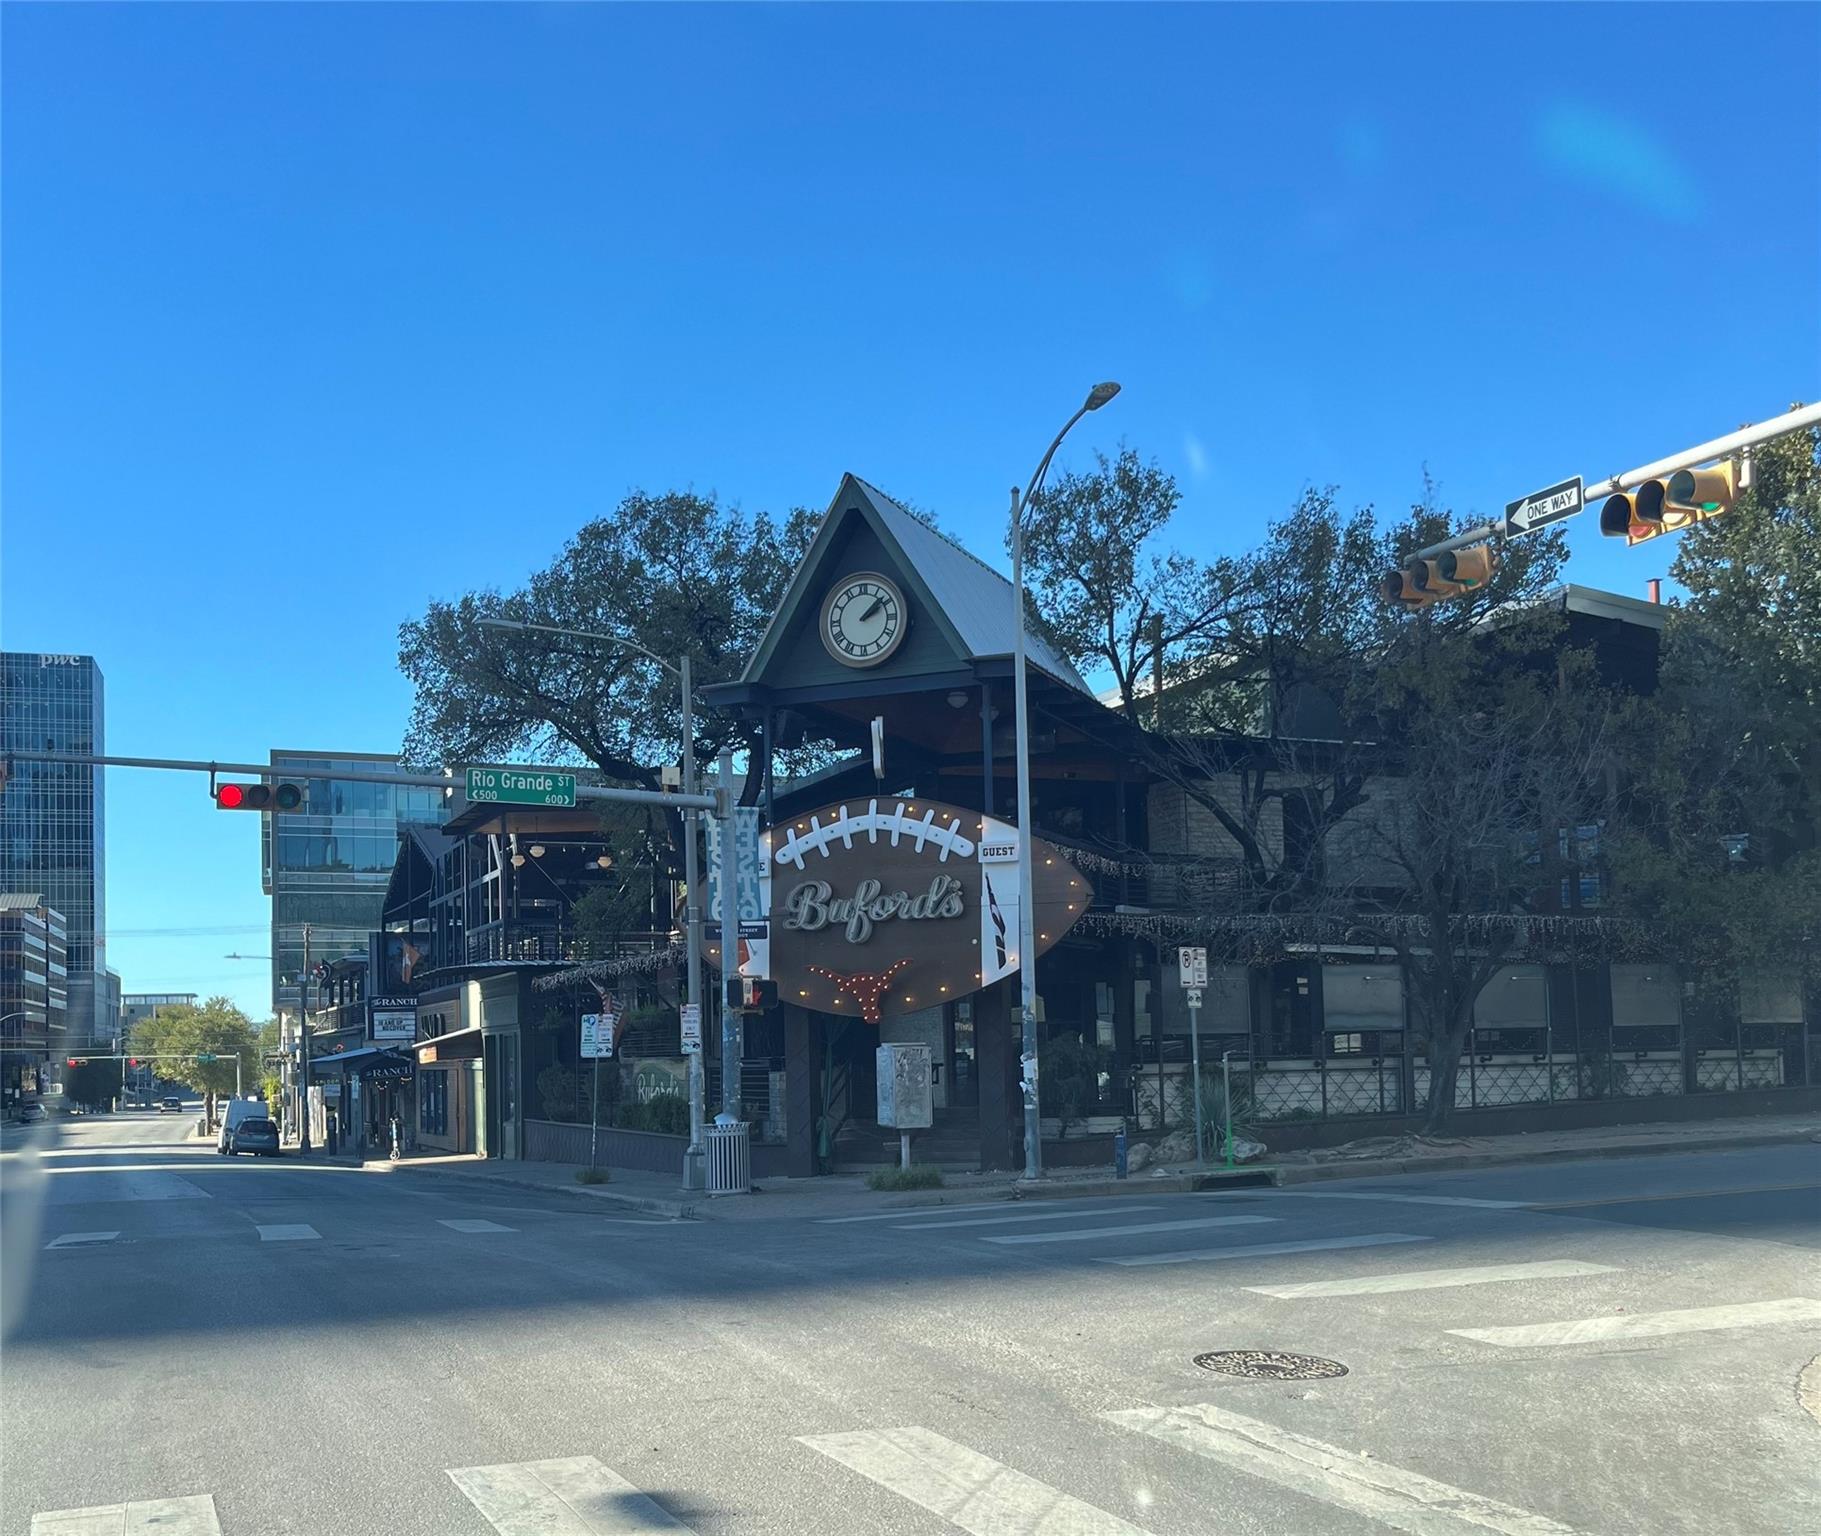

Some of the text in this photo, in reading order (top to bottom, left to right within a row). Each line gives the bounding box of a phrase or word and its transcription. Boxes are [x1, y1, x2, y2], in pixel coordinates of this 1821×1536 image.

[1527, 491, 1573, 519] ONE WAY
[41, 654, 80, 669] pwc
[471, 770, 570, 791] Rio Grande ST
[479, 790, 498, 800] 500
[545, 794, 563, 804] 600
[982, 846, 1015, 857] GUEST
[783, 874, 964, 943] Buford's
[382, 998, 417, 1006] RANCH
[372, 1066, 412, 1077] RANCH
